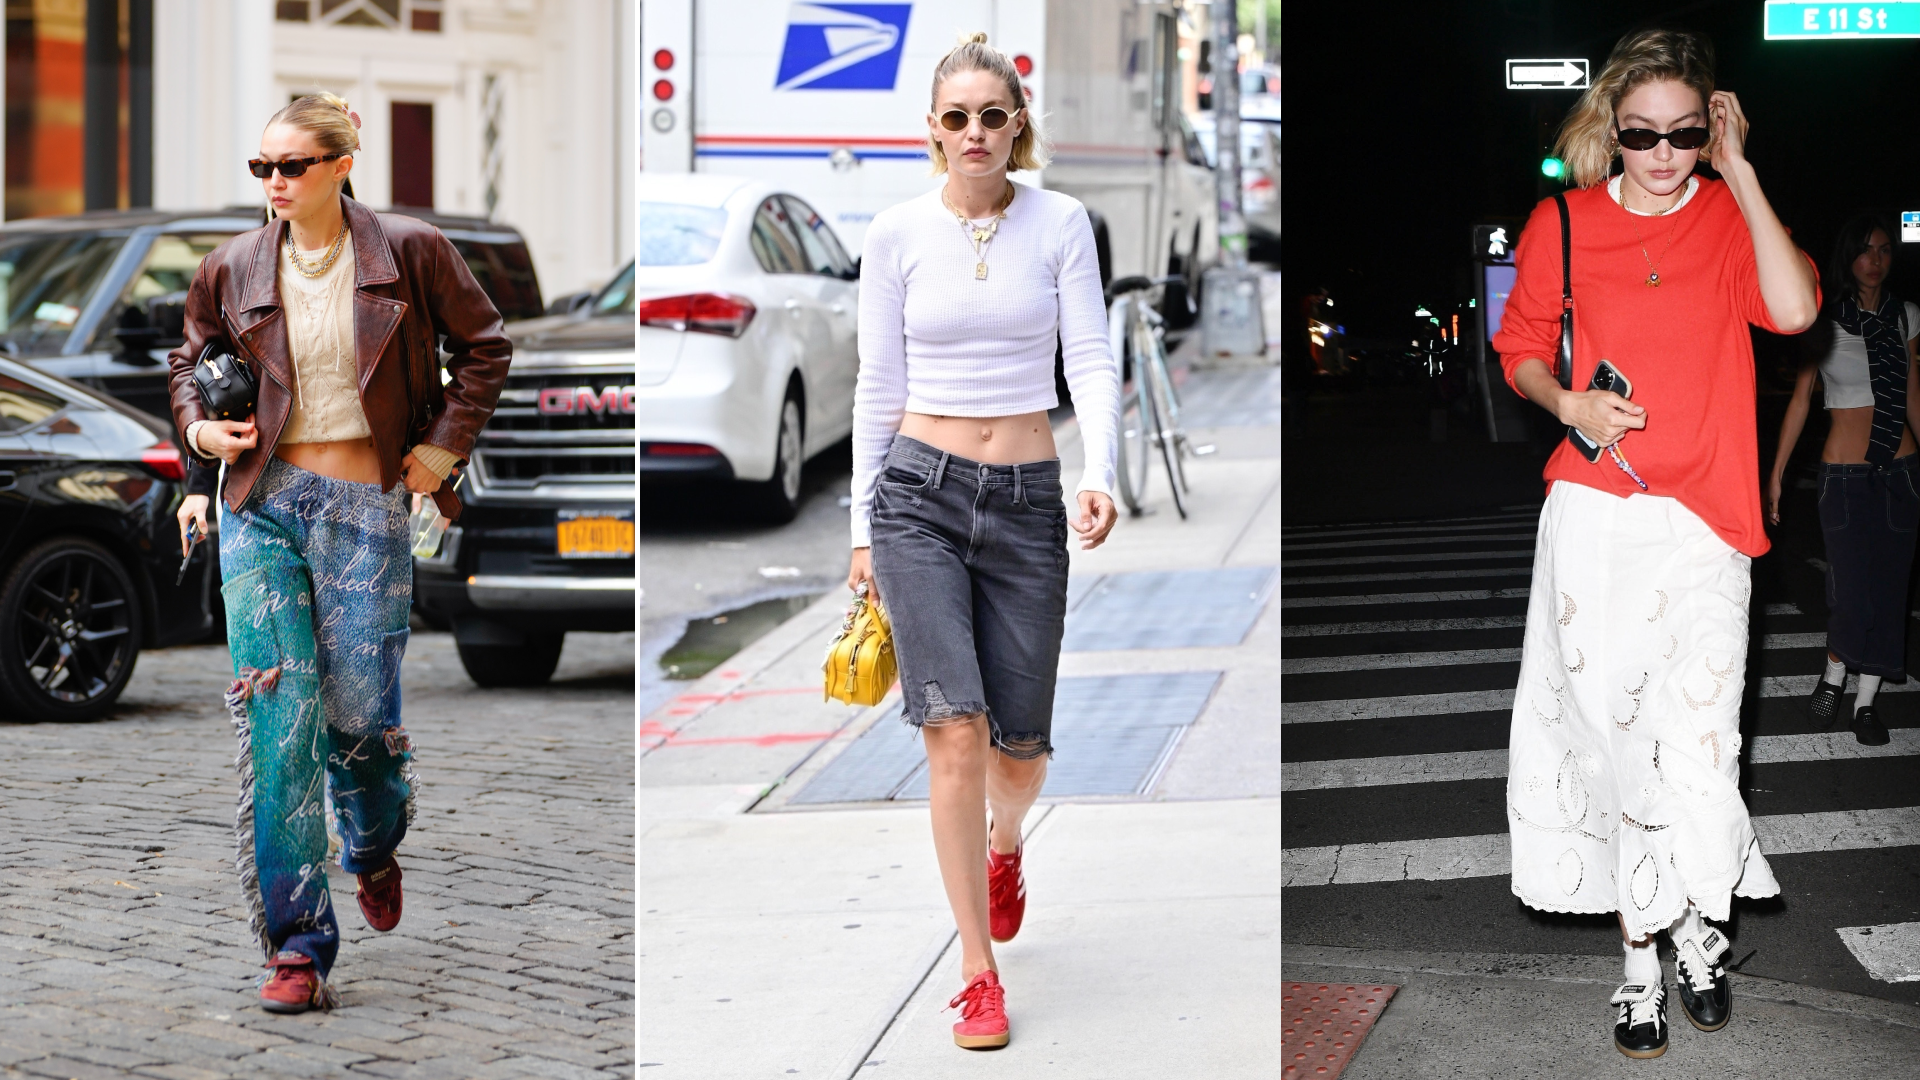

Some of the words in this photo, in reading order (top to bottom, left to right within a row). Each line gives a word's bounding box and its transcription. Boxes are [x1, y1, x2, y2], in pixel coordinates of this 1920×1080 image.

[1803, 8, 1820, 30] E
[1828, 8, 1848, 30] 11
[1857, 7, 1888, 30] St
